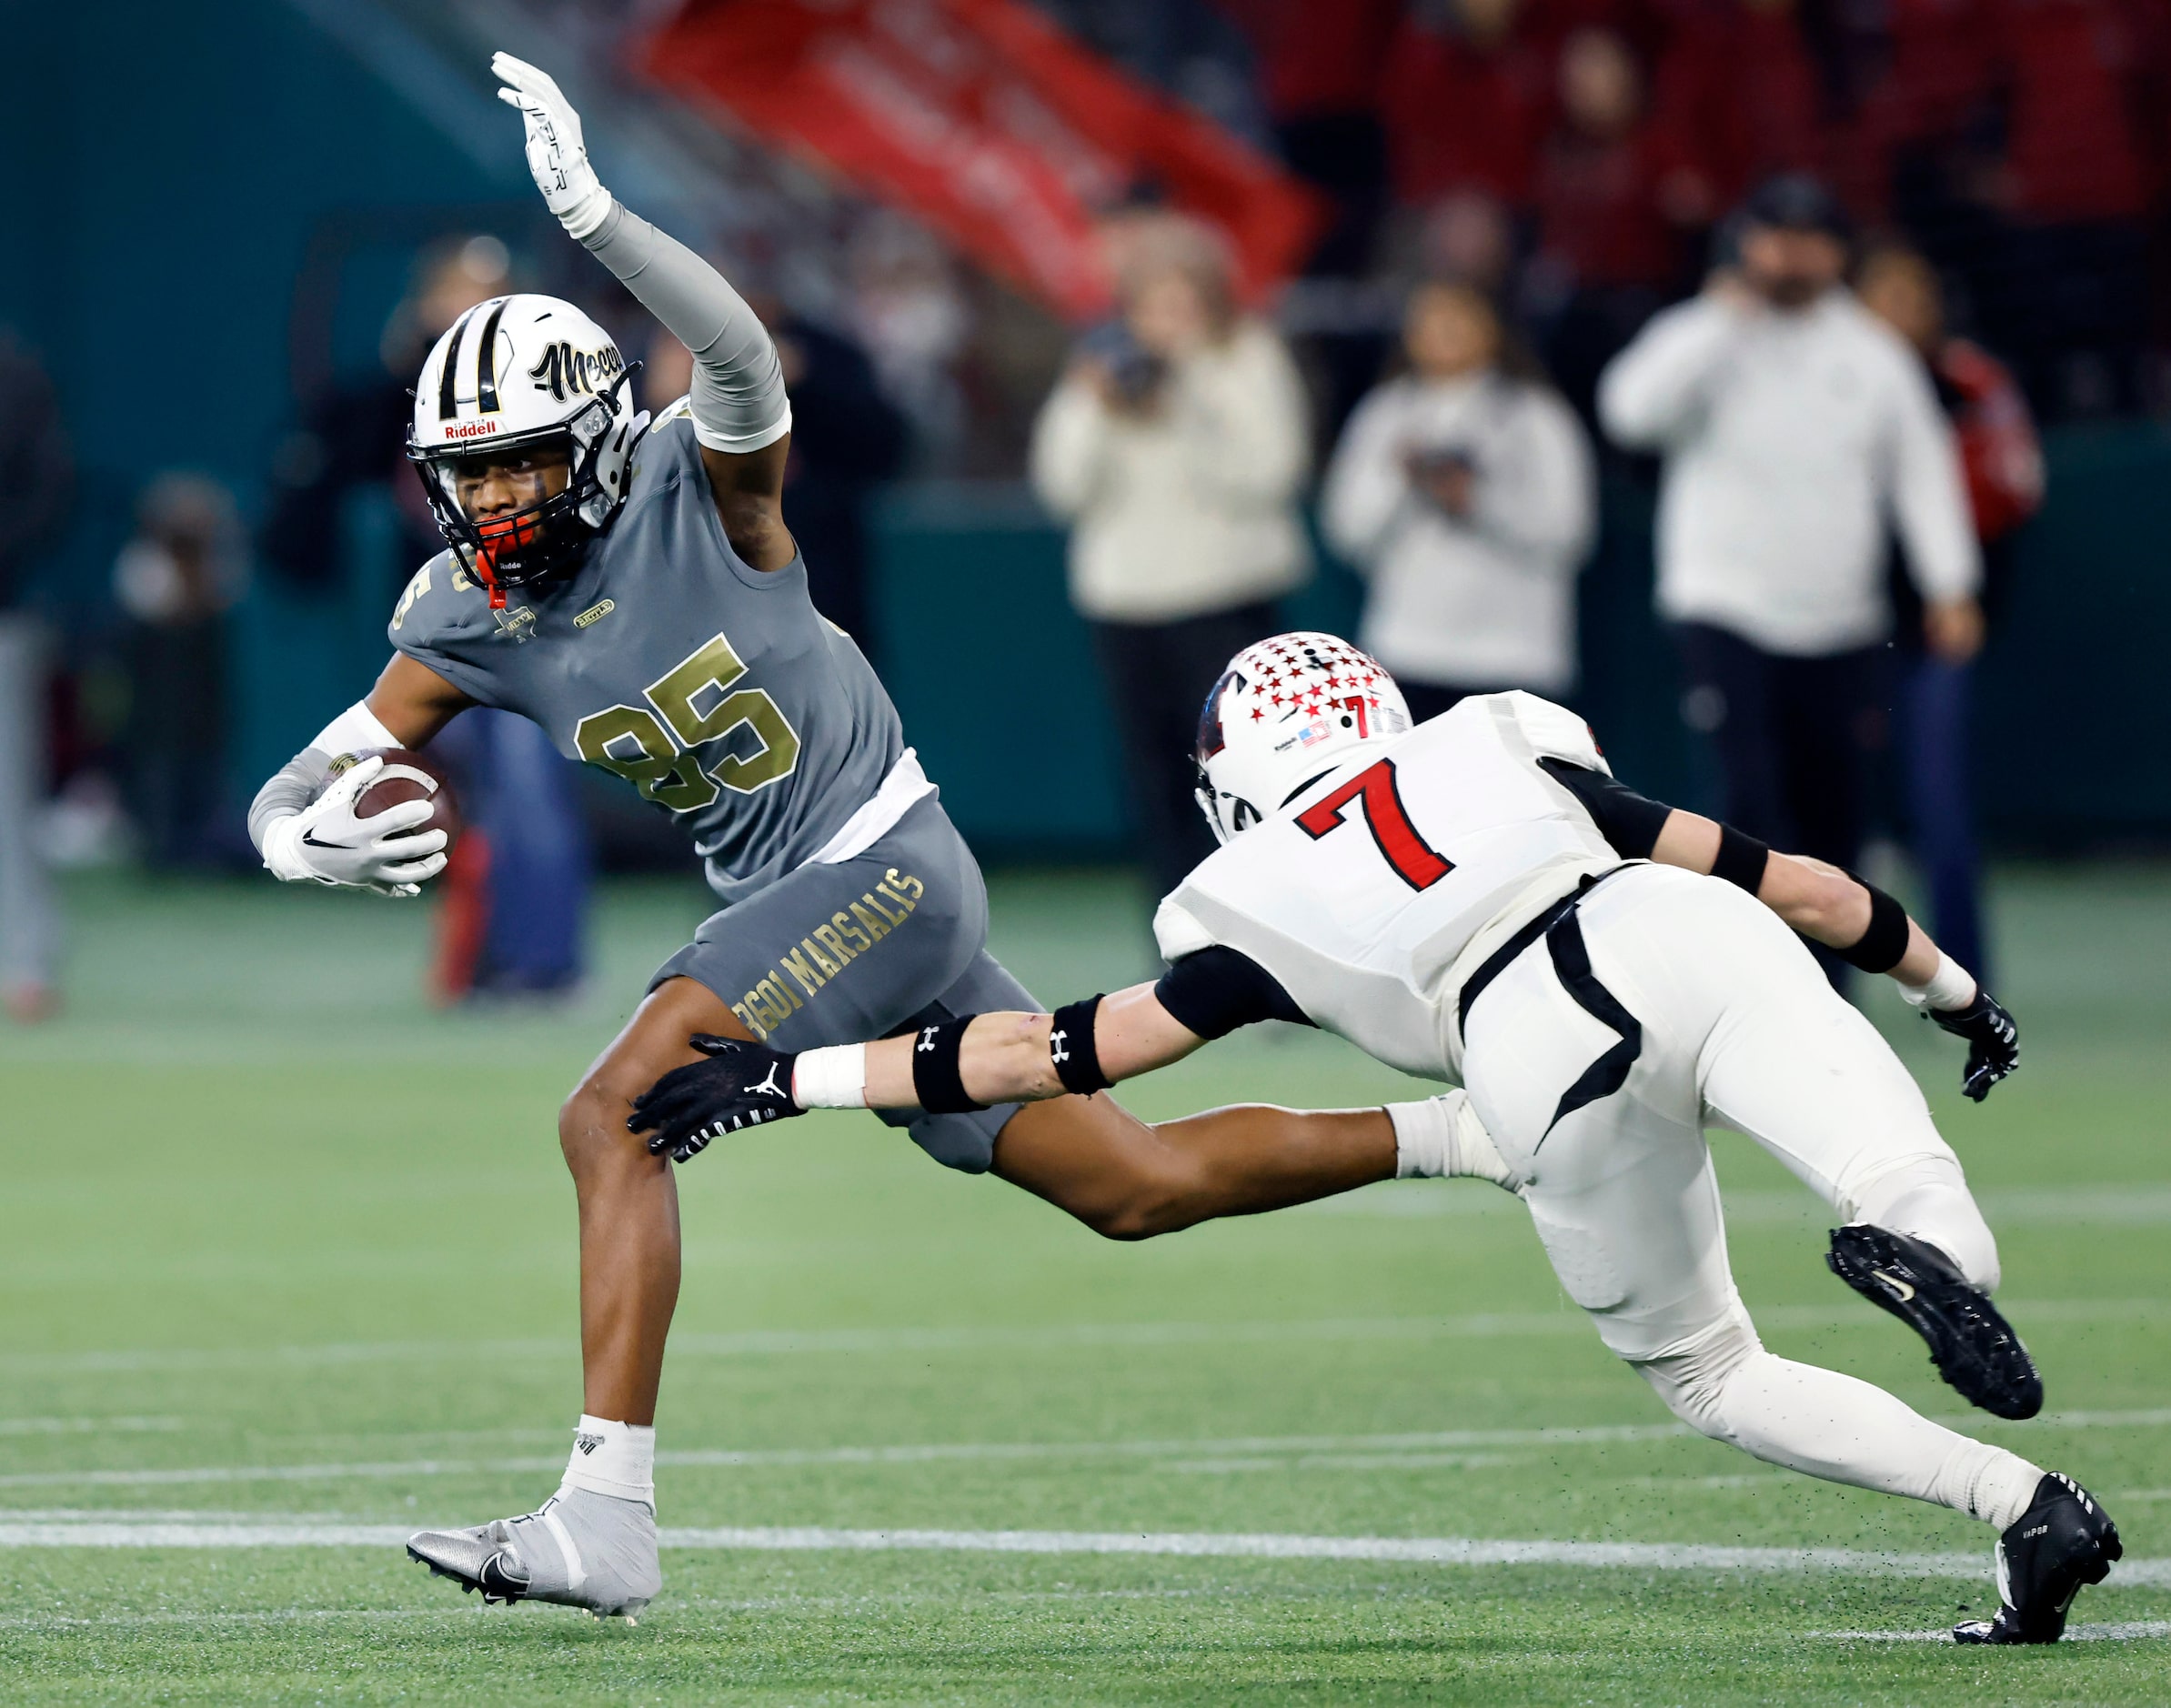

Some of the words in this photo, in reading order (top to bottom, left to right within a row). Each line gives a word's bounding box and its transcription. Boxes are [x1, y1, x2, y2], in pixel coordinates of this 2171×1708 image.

[445, 420, 496, 438] Riddell
[574, 631, 801, 813] 85
[1343, 695, 1369, 738] 7
[1292, 757, 1457, 893] 7
[731, 970, 804, 1041] 3601
[779, 868, 924, 997] MARSALIS
[2023, 1525, 2048, 1538] VAPOR
